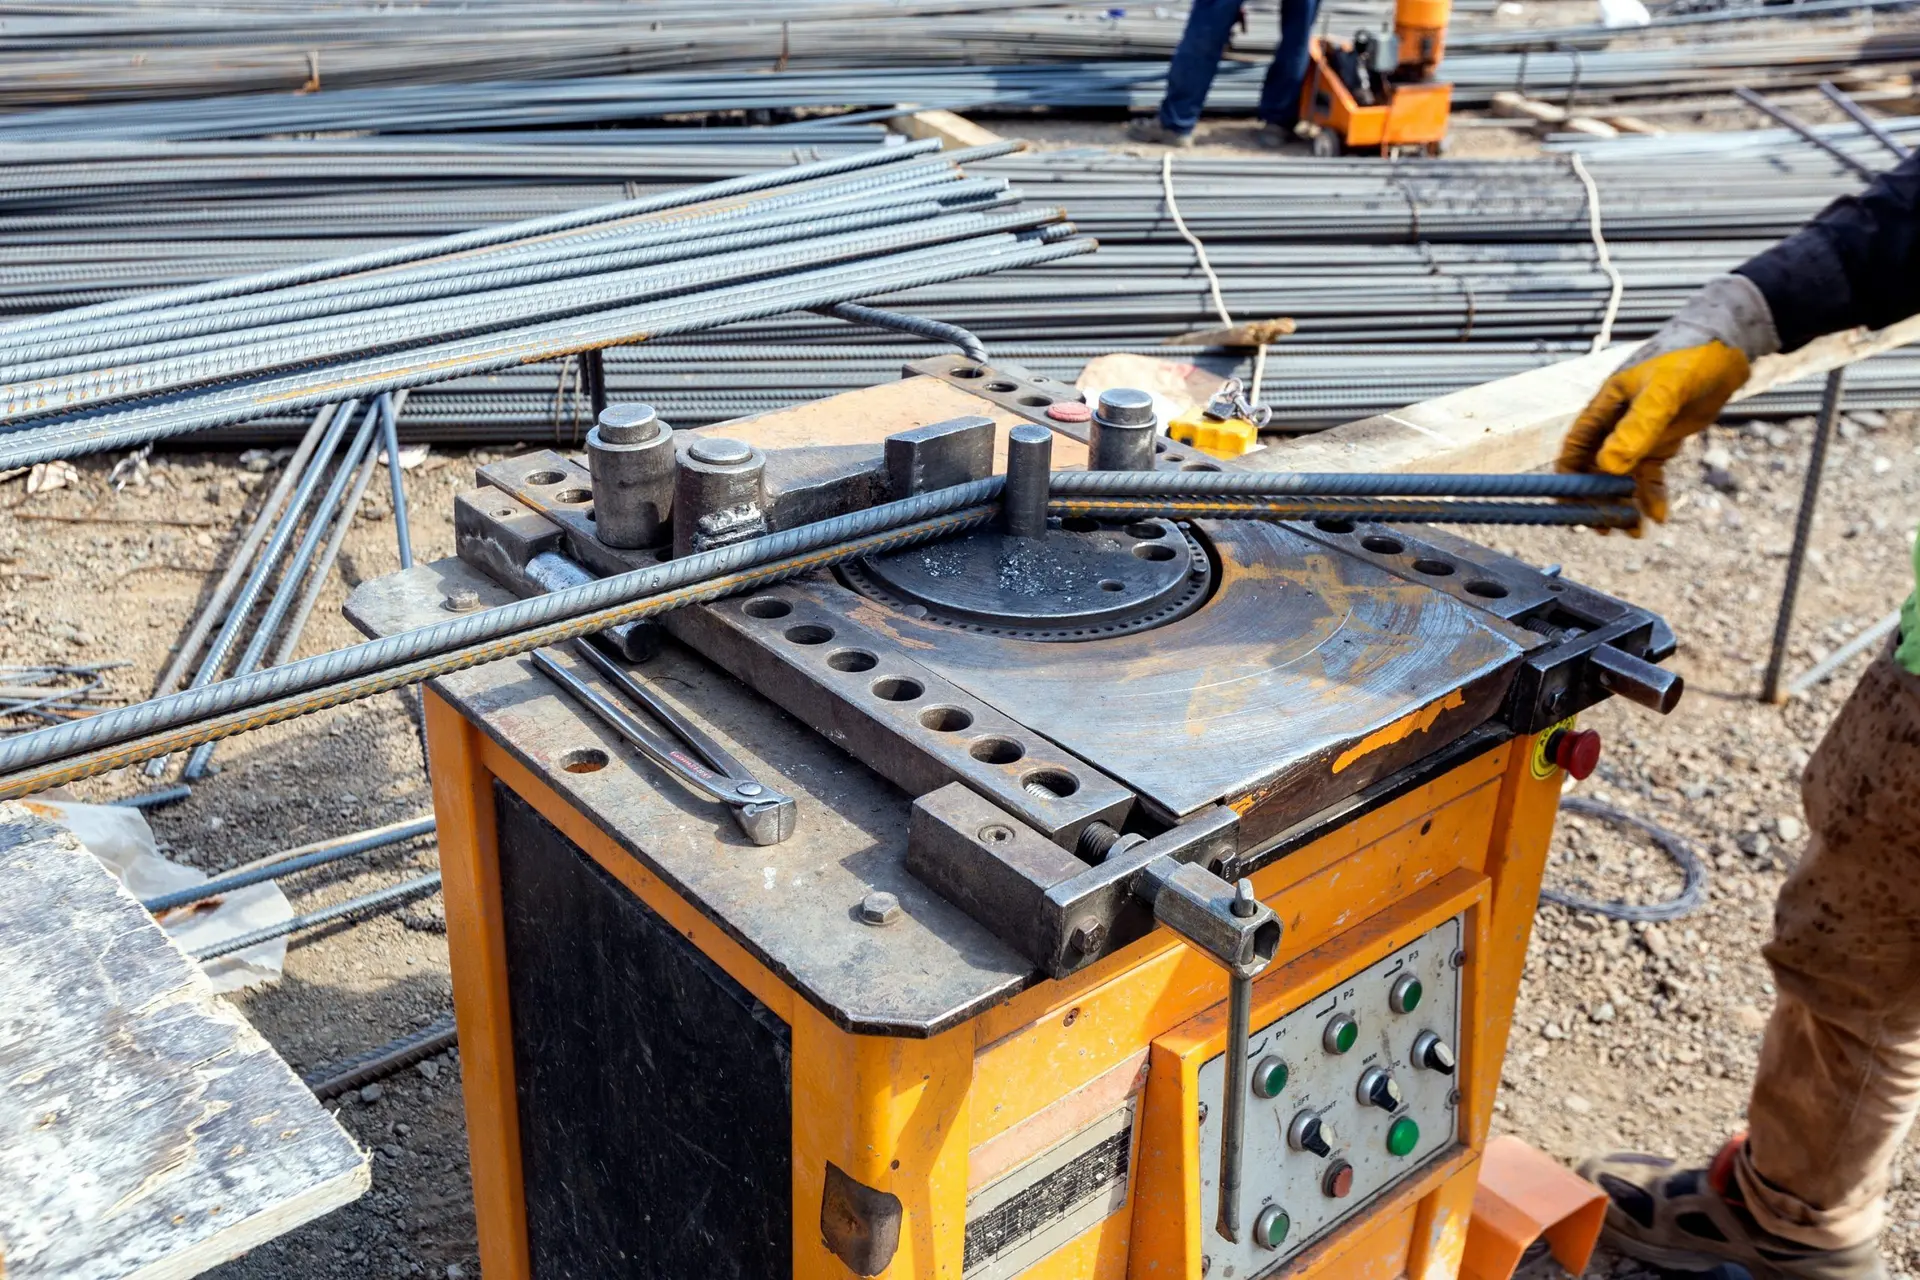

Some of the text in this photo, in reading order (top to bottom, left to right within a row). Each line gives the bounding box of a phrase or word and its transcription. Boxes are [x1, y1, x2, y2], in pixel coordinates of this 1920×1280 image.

[1408, 950, 1419, 963] P3
[1343, 988, 1355, 1001] P2
[1275, 1028, 1286, 1041] P1
[1293, 1094, 1311, 1109] LEFT
[1261, 1194, 1273, 1206] ON
